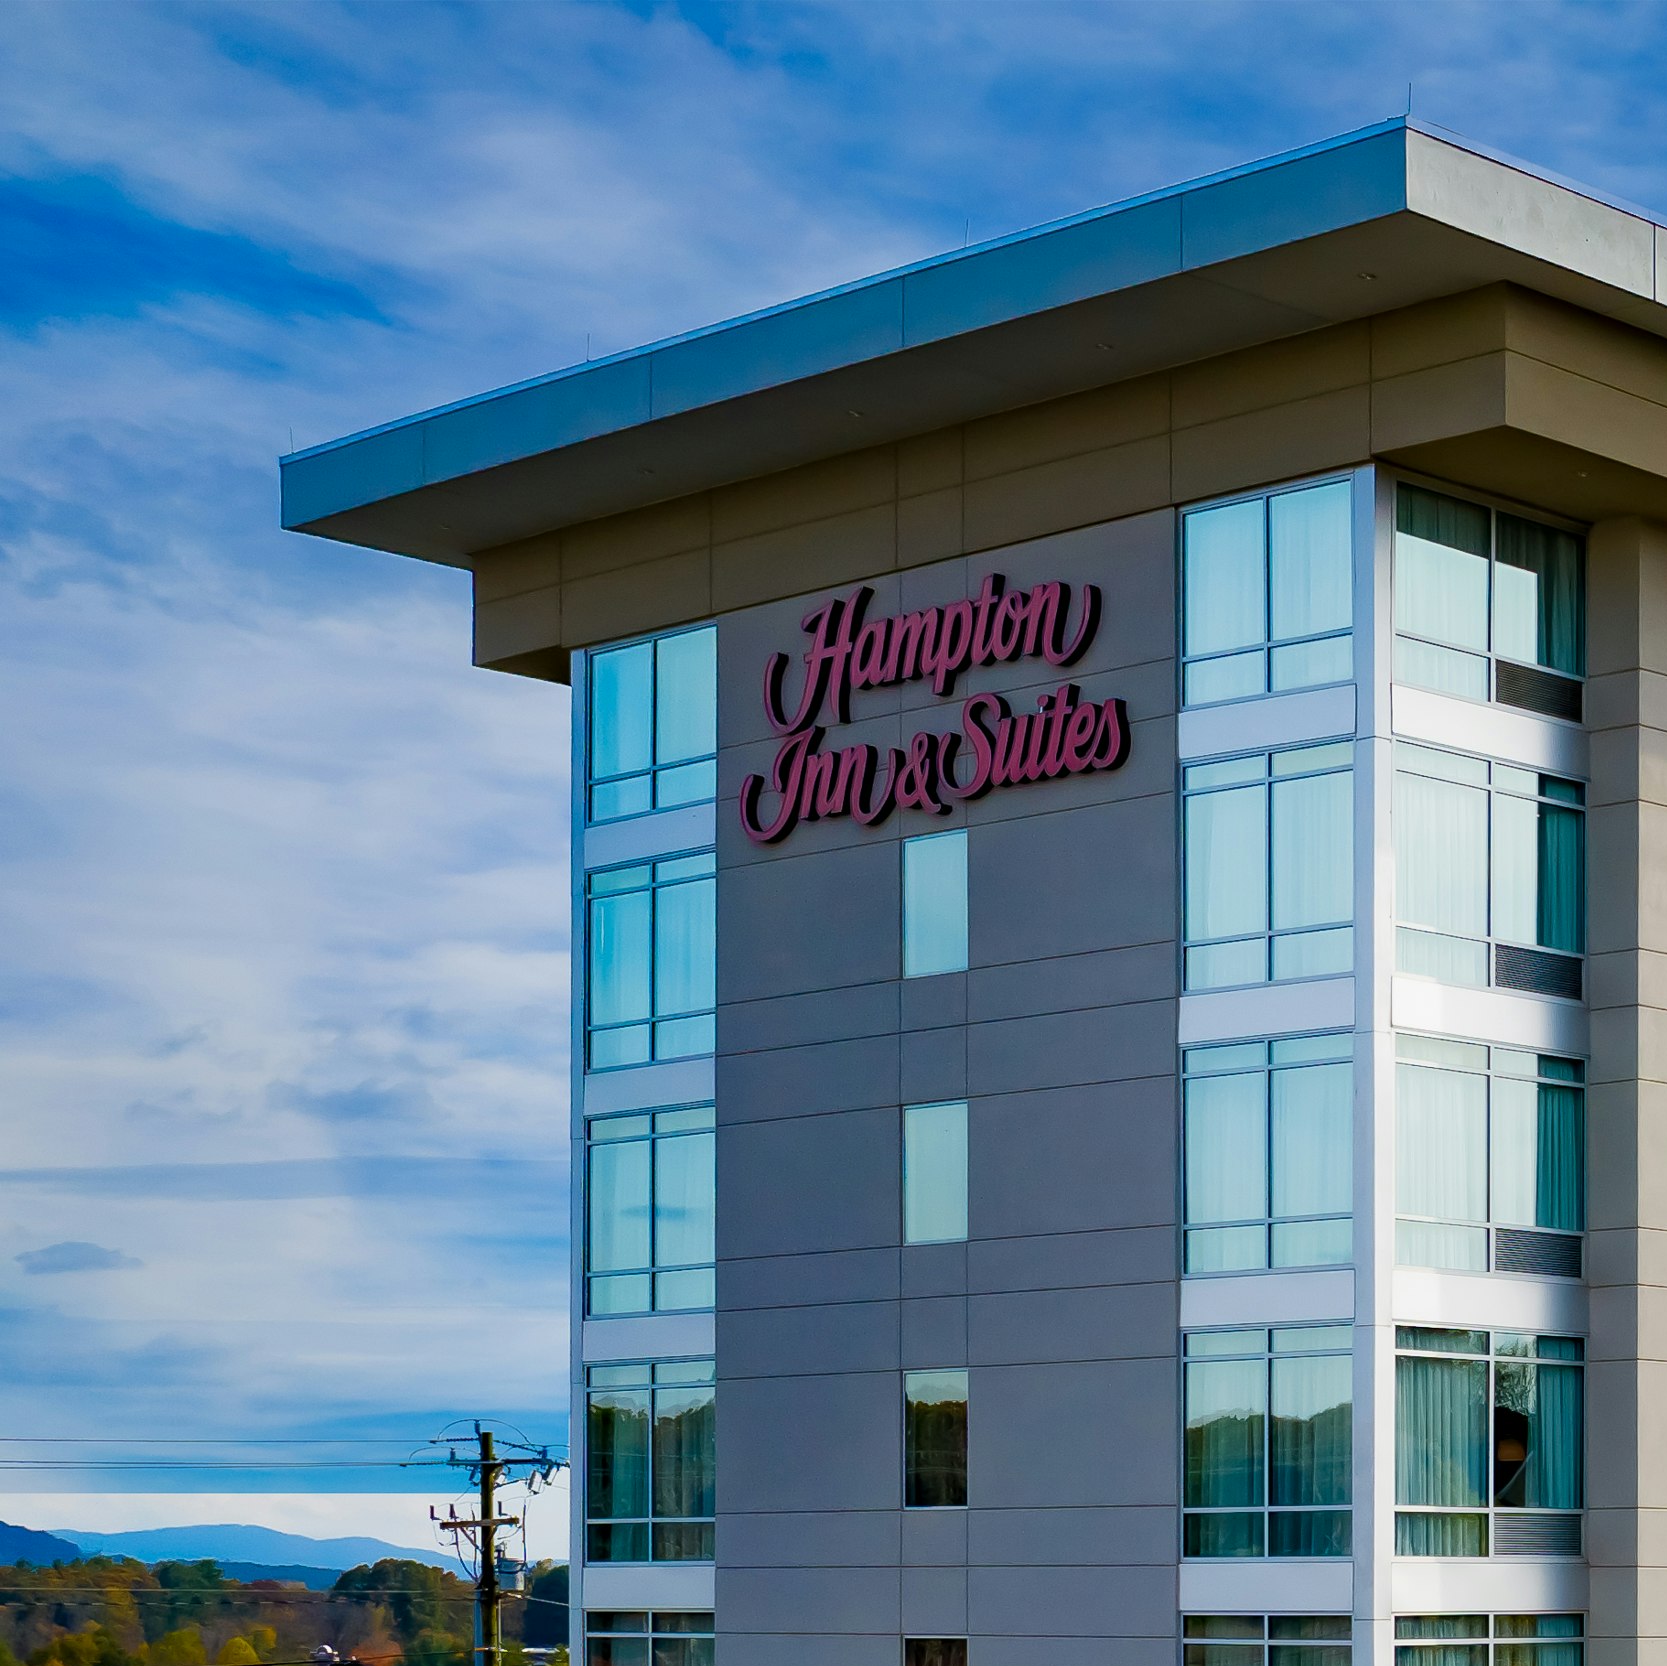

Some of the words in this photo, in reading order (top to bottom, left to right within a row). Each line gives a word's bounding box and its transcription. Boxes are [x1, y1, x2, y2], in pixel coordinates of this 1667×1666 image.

[763, 572, 1102, 736] Hampton
[740, 726, 898, 845] Inn
[896, 731, 953, 816] &
[938, 683, 1132, 800] Suites
